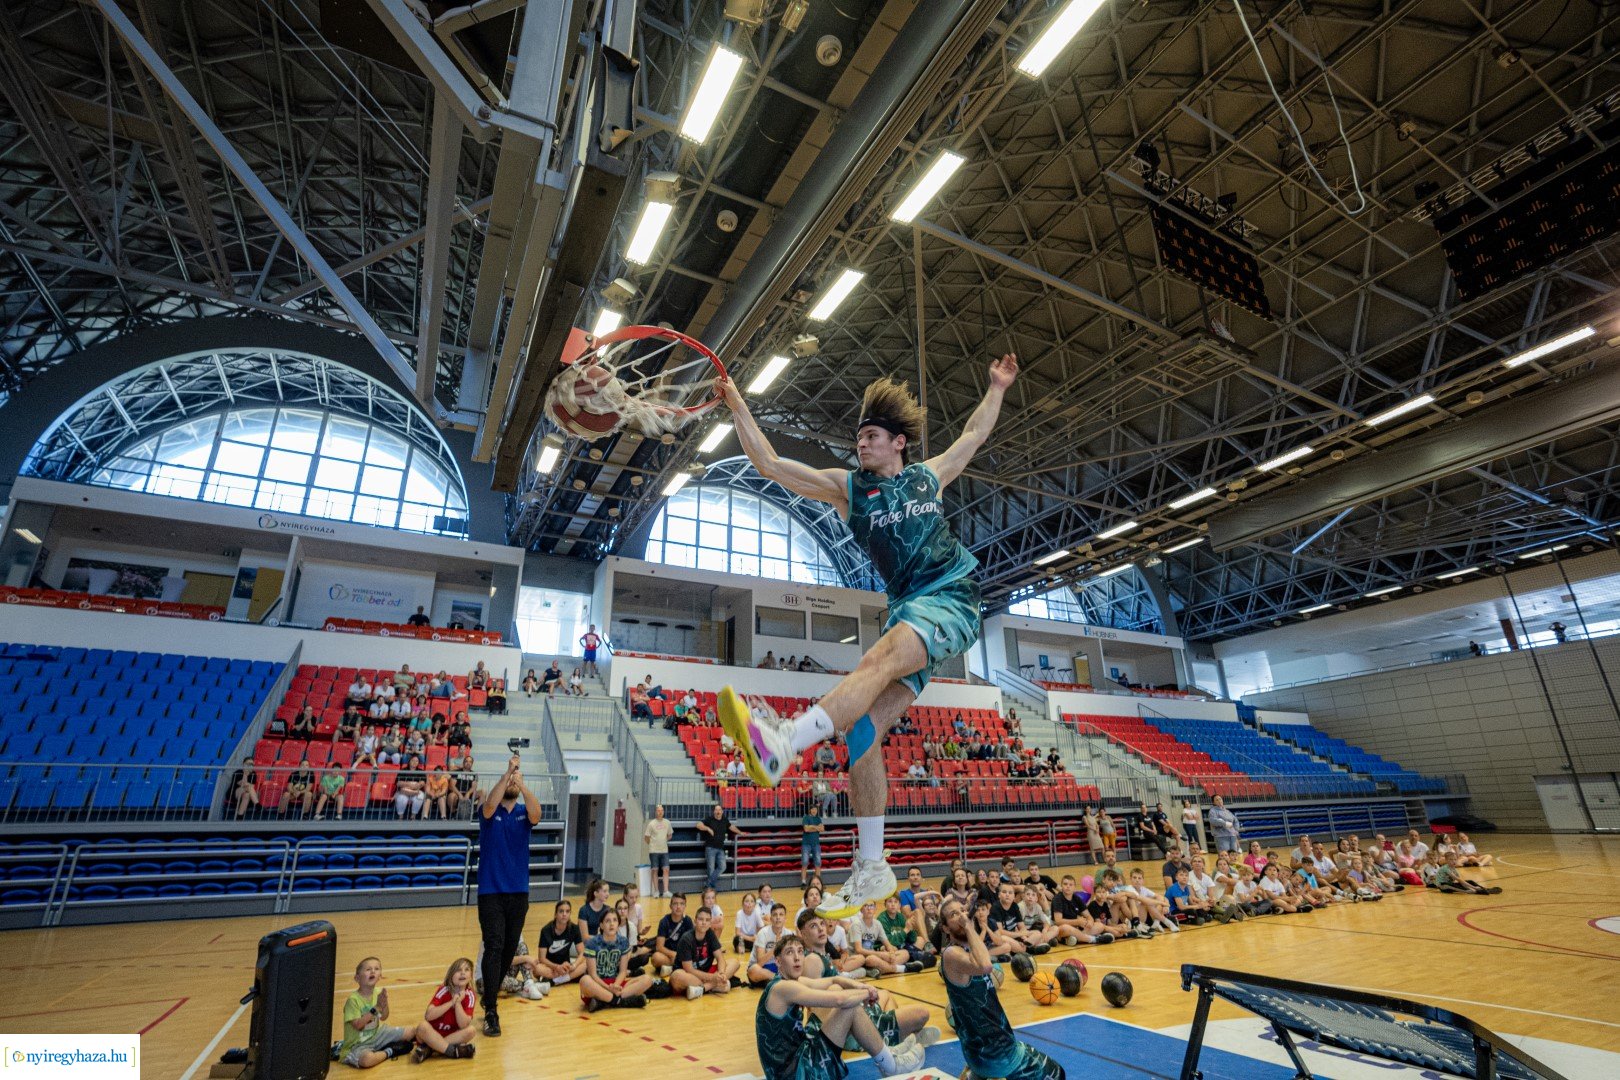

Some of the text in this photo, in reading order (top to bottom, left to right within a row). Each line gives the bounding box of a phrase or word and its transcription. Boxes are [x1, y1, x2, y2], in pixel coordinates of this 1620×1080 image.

[869, 509, 904, 531] Face
[280, 521, 335, 534] NYÍREGYHÁZA
[785, 595, 798, 604] BH
